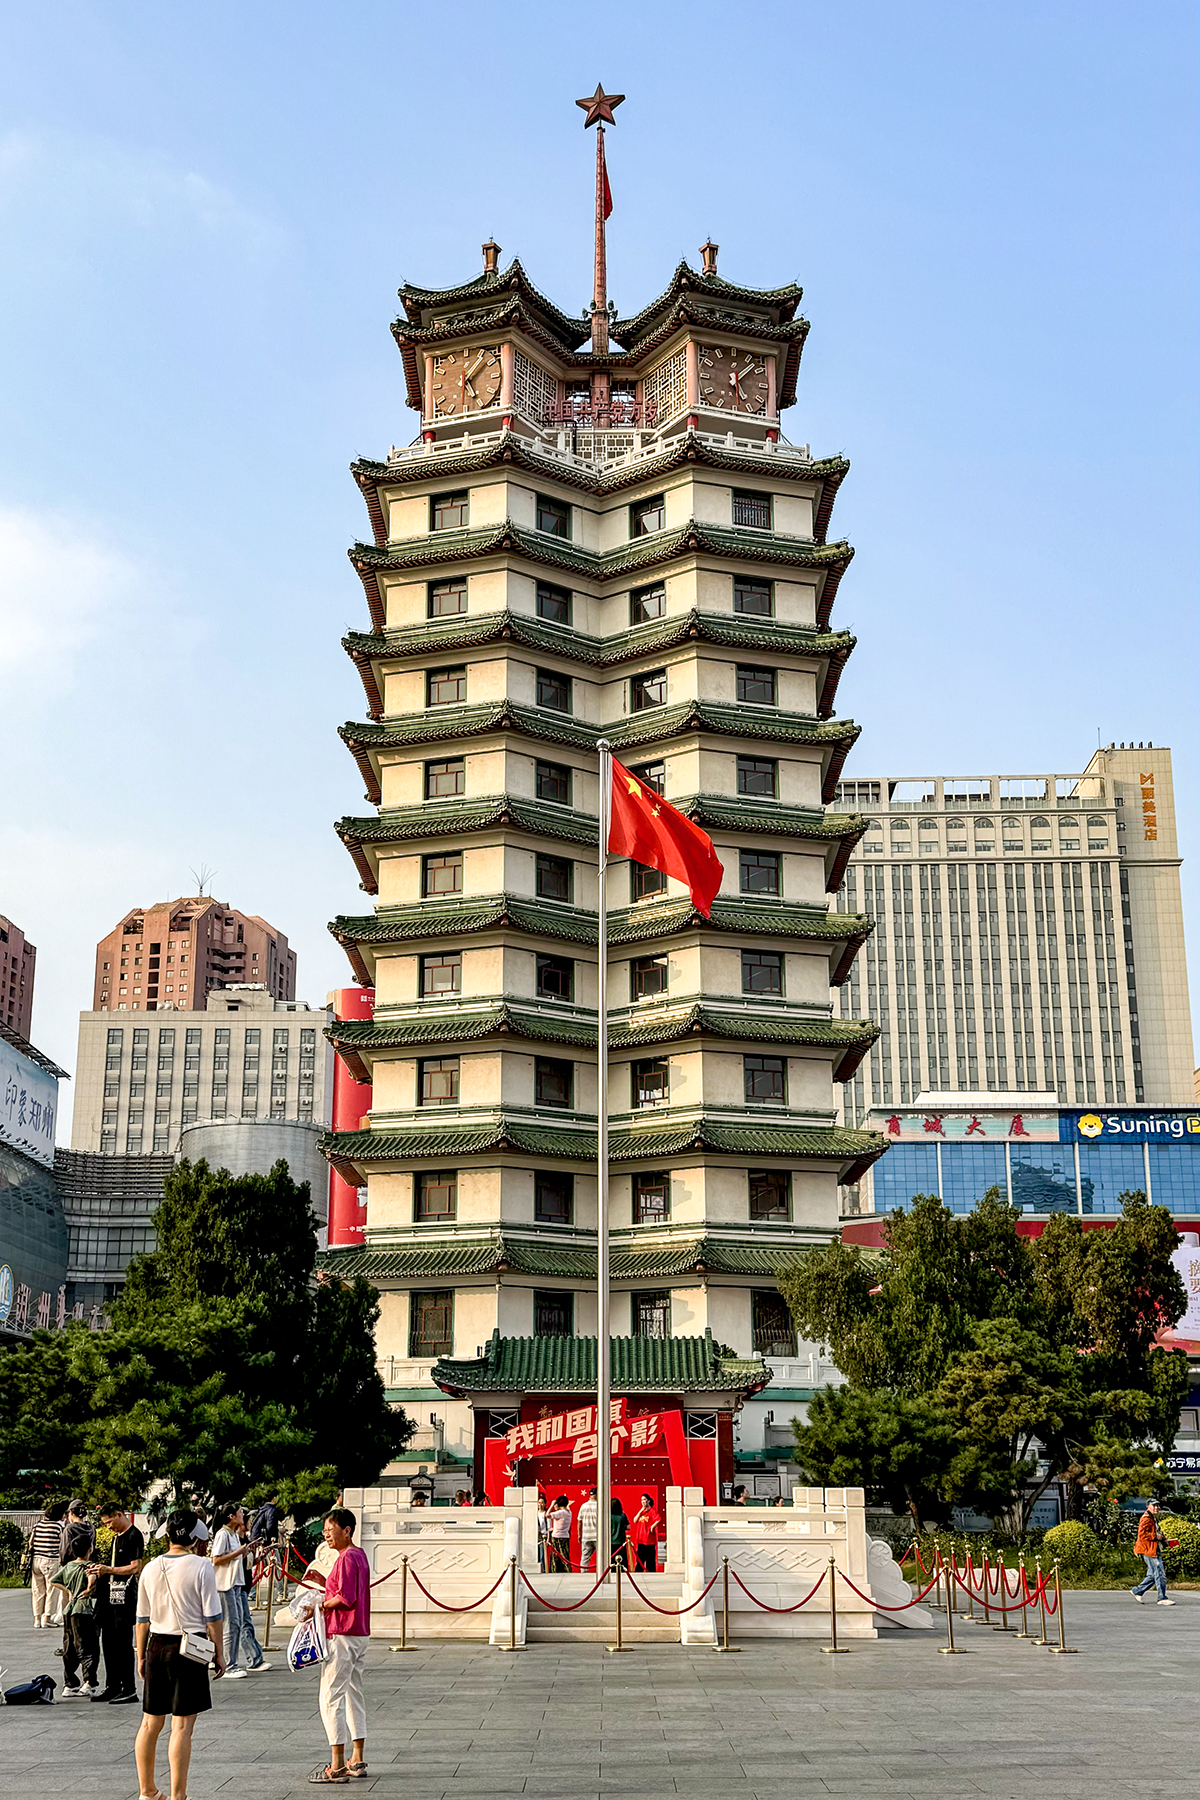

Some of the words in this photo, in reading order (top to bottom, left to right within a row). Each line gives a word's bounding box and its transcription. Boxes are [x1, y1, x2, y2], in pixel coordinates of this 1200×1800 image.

[543, 399, 659, 423] 中国共产党万岁
[884, 1114, 1030, 1138] 商城大厦
[1106, 1115, 1184, 1138] Suning
[572, 1416, 658, 1465] 合个影
